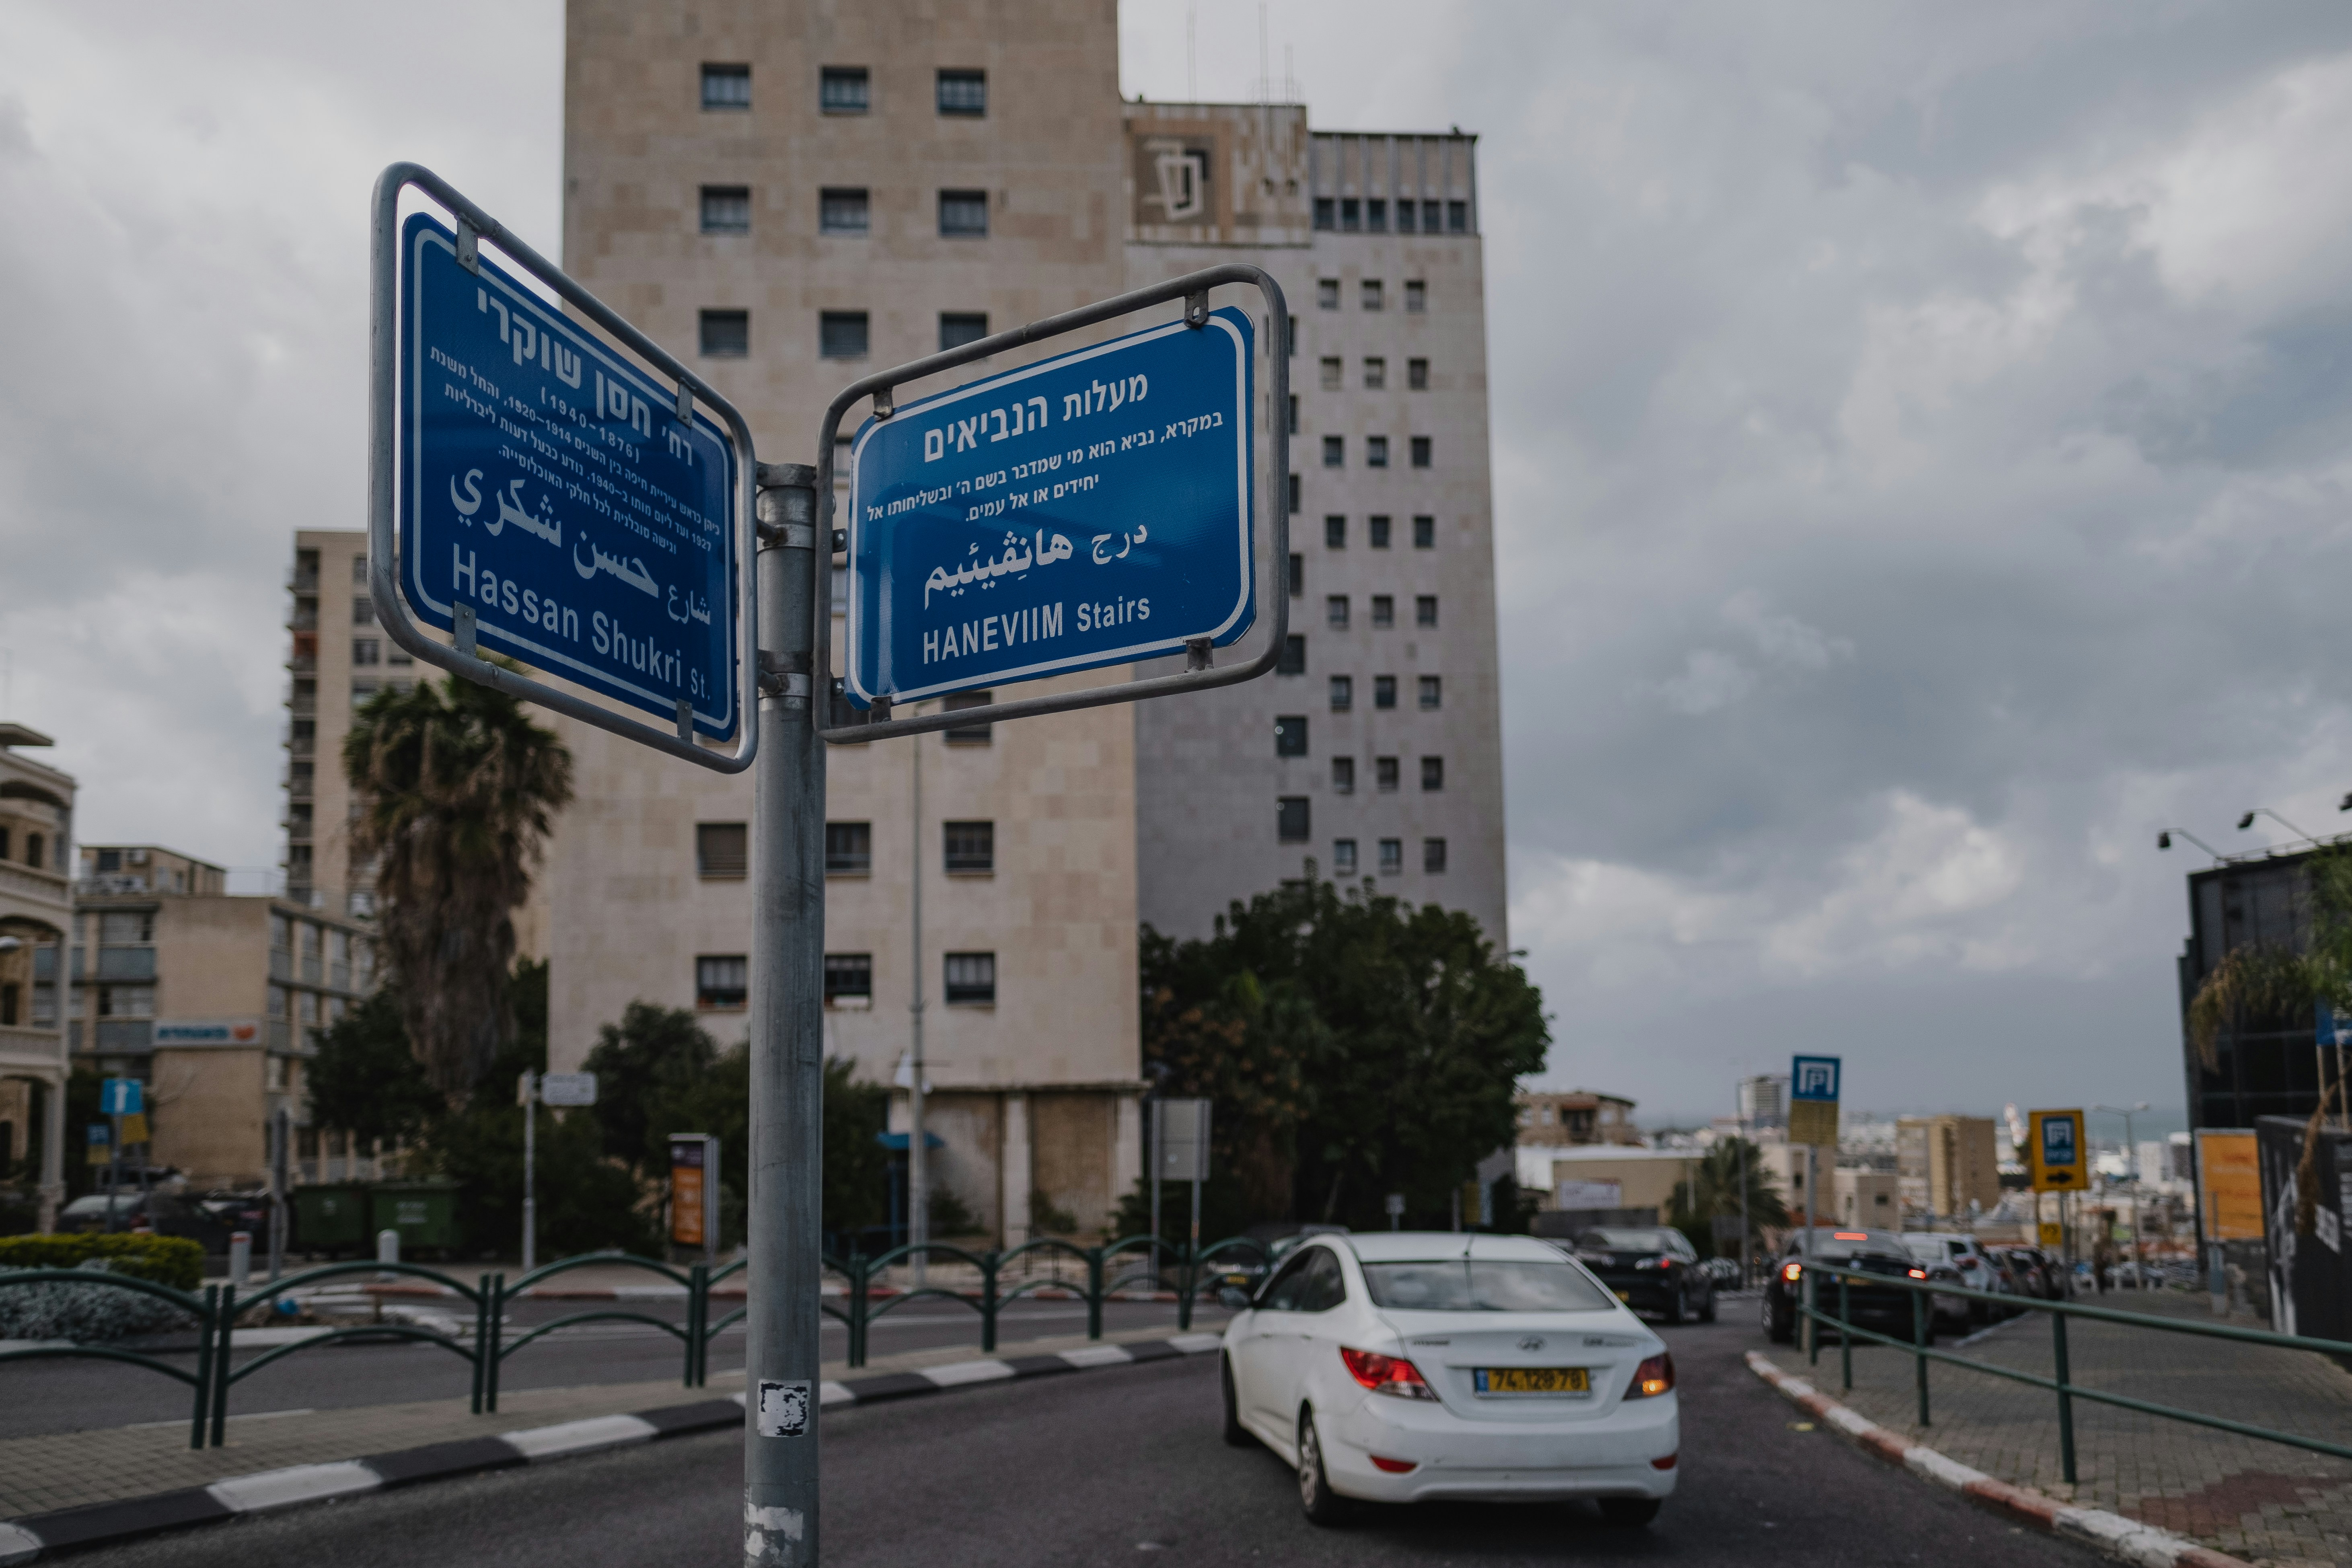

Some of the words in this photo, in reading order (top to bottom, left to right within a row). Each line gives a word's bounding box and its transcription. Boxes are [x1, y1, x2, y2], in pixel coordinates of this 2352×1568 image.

[477, 287, 582, 390] שוקרי
[430, 346, 467, 379] משנת
[470, 366, 500, 399] והחל
[444, 383, 496, 423] ליברליות
[595, 369, 651, 438] חסן
[1063, 374, 1148, 421] מעלות
[500, 417, 528, 443] דעות
[924, 396, 1048, 463] הנביאים
[1160, 411, 1223, 443] במקרא,
[530, 430, 558, 460] כבעל
[574, 436, 606, 465] השנים
[1088, 440, 1116, 460] הוא
[1121, 429, 1155, 451] נביא
[561, 453, 584, 476] נודע
[609, 458, 622, 475] בין
[1011, 454, 1062, 480] שמדבר
[1067, 448, 1083, 464] מי
[625, 469, 648, 491] חיפה
[975, 470, 1007, 491] בשם
[1053, 474, 1099, 499] יחידים
[566, 482, 590, 505] חלקי
[592, 493, 611, 516] לכל
[631, 496, 652, 516] מותו
[650, 484, 677, 509] עיריית
[887, 485, 952, 516] ובשליחותו
[1009, 492, 1028, 510] אל
[1033, 487, 1049, 504] או
[450, 468, 561, 548] شكري
[654, 510, 672, 528] ליום
[679, 503, 701, 524] כראש
[866, 505, 884, 522] אל
[965, 498, 1005, 522] עמים.
[613, 510, 650, 539] סובלנית
[675, 522, 689, 539] ועד
[652, 532, 676, 554] וגישה
[692, 533, 712, 552] 1927
[1091, 524, 1148, 565] درج
[573, 530, 659, 598] حسن
[668, 585, 711, 625] شارع
[453, 543, 578, 642] Hassan
[592, 610, 681, 687] Shukri
[691, 668, 710, 700] St.
[923, 602, 1063, 664] HANEVIIM
[1077, 595, 1150, 632] Stairs
